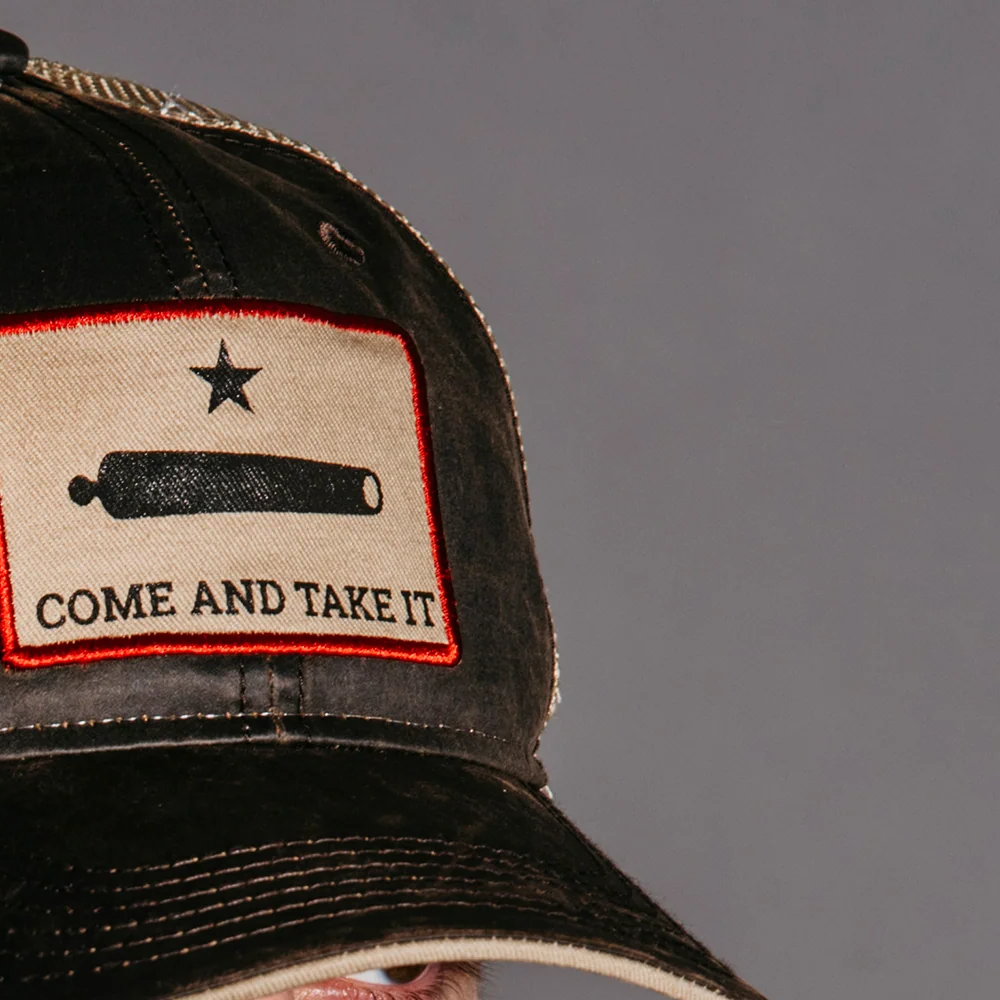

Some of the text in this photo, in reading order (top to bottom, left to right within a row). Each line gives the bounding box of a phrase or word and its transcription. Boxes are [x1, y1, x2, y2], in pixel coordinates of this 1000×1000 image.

[36, 578, 436, 630] COME AND TAKE IT
